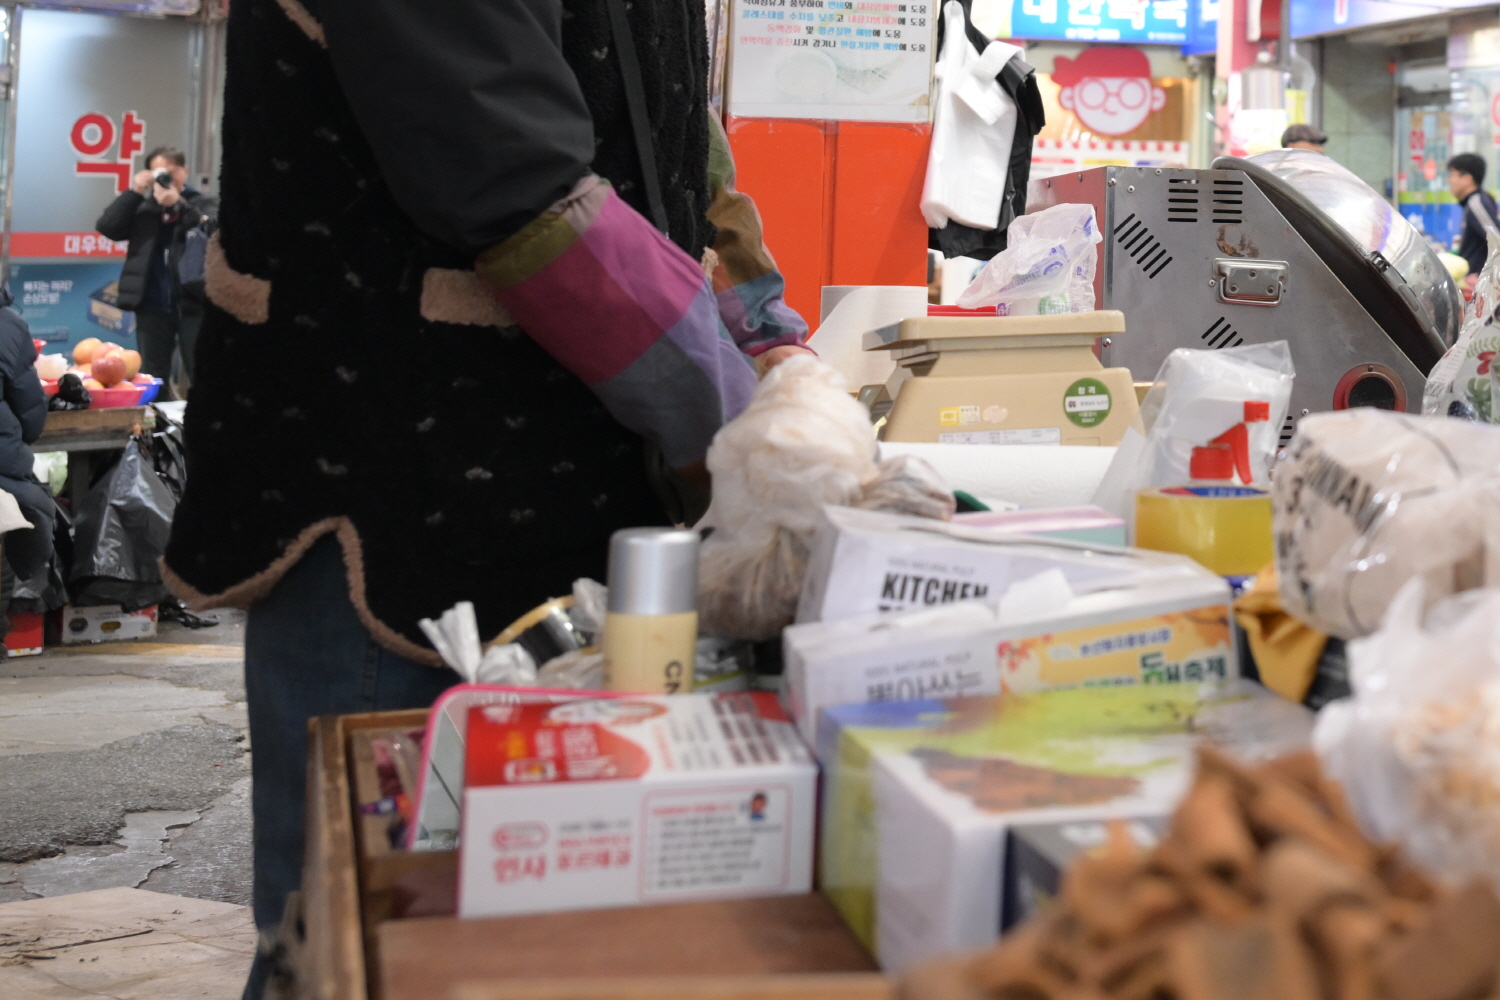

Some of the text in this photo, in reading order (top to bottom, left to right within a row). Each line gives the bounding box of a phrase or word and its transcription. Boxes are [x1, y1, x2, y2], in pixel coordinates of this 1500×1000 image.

[911, 4, 927, 15] 도움
[911, 17, 926, 27] 도움
[805, 25, 814, 35] 및
[885, 29, 901, 39] 도움
[813, 38, 837, 48] 감기나
[910, 43, 926, 53] 도움
[70, 111, 145, 193] 약
[881, 572, 989, 606] KITCHEN
